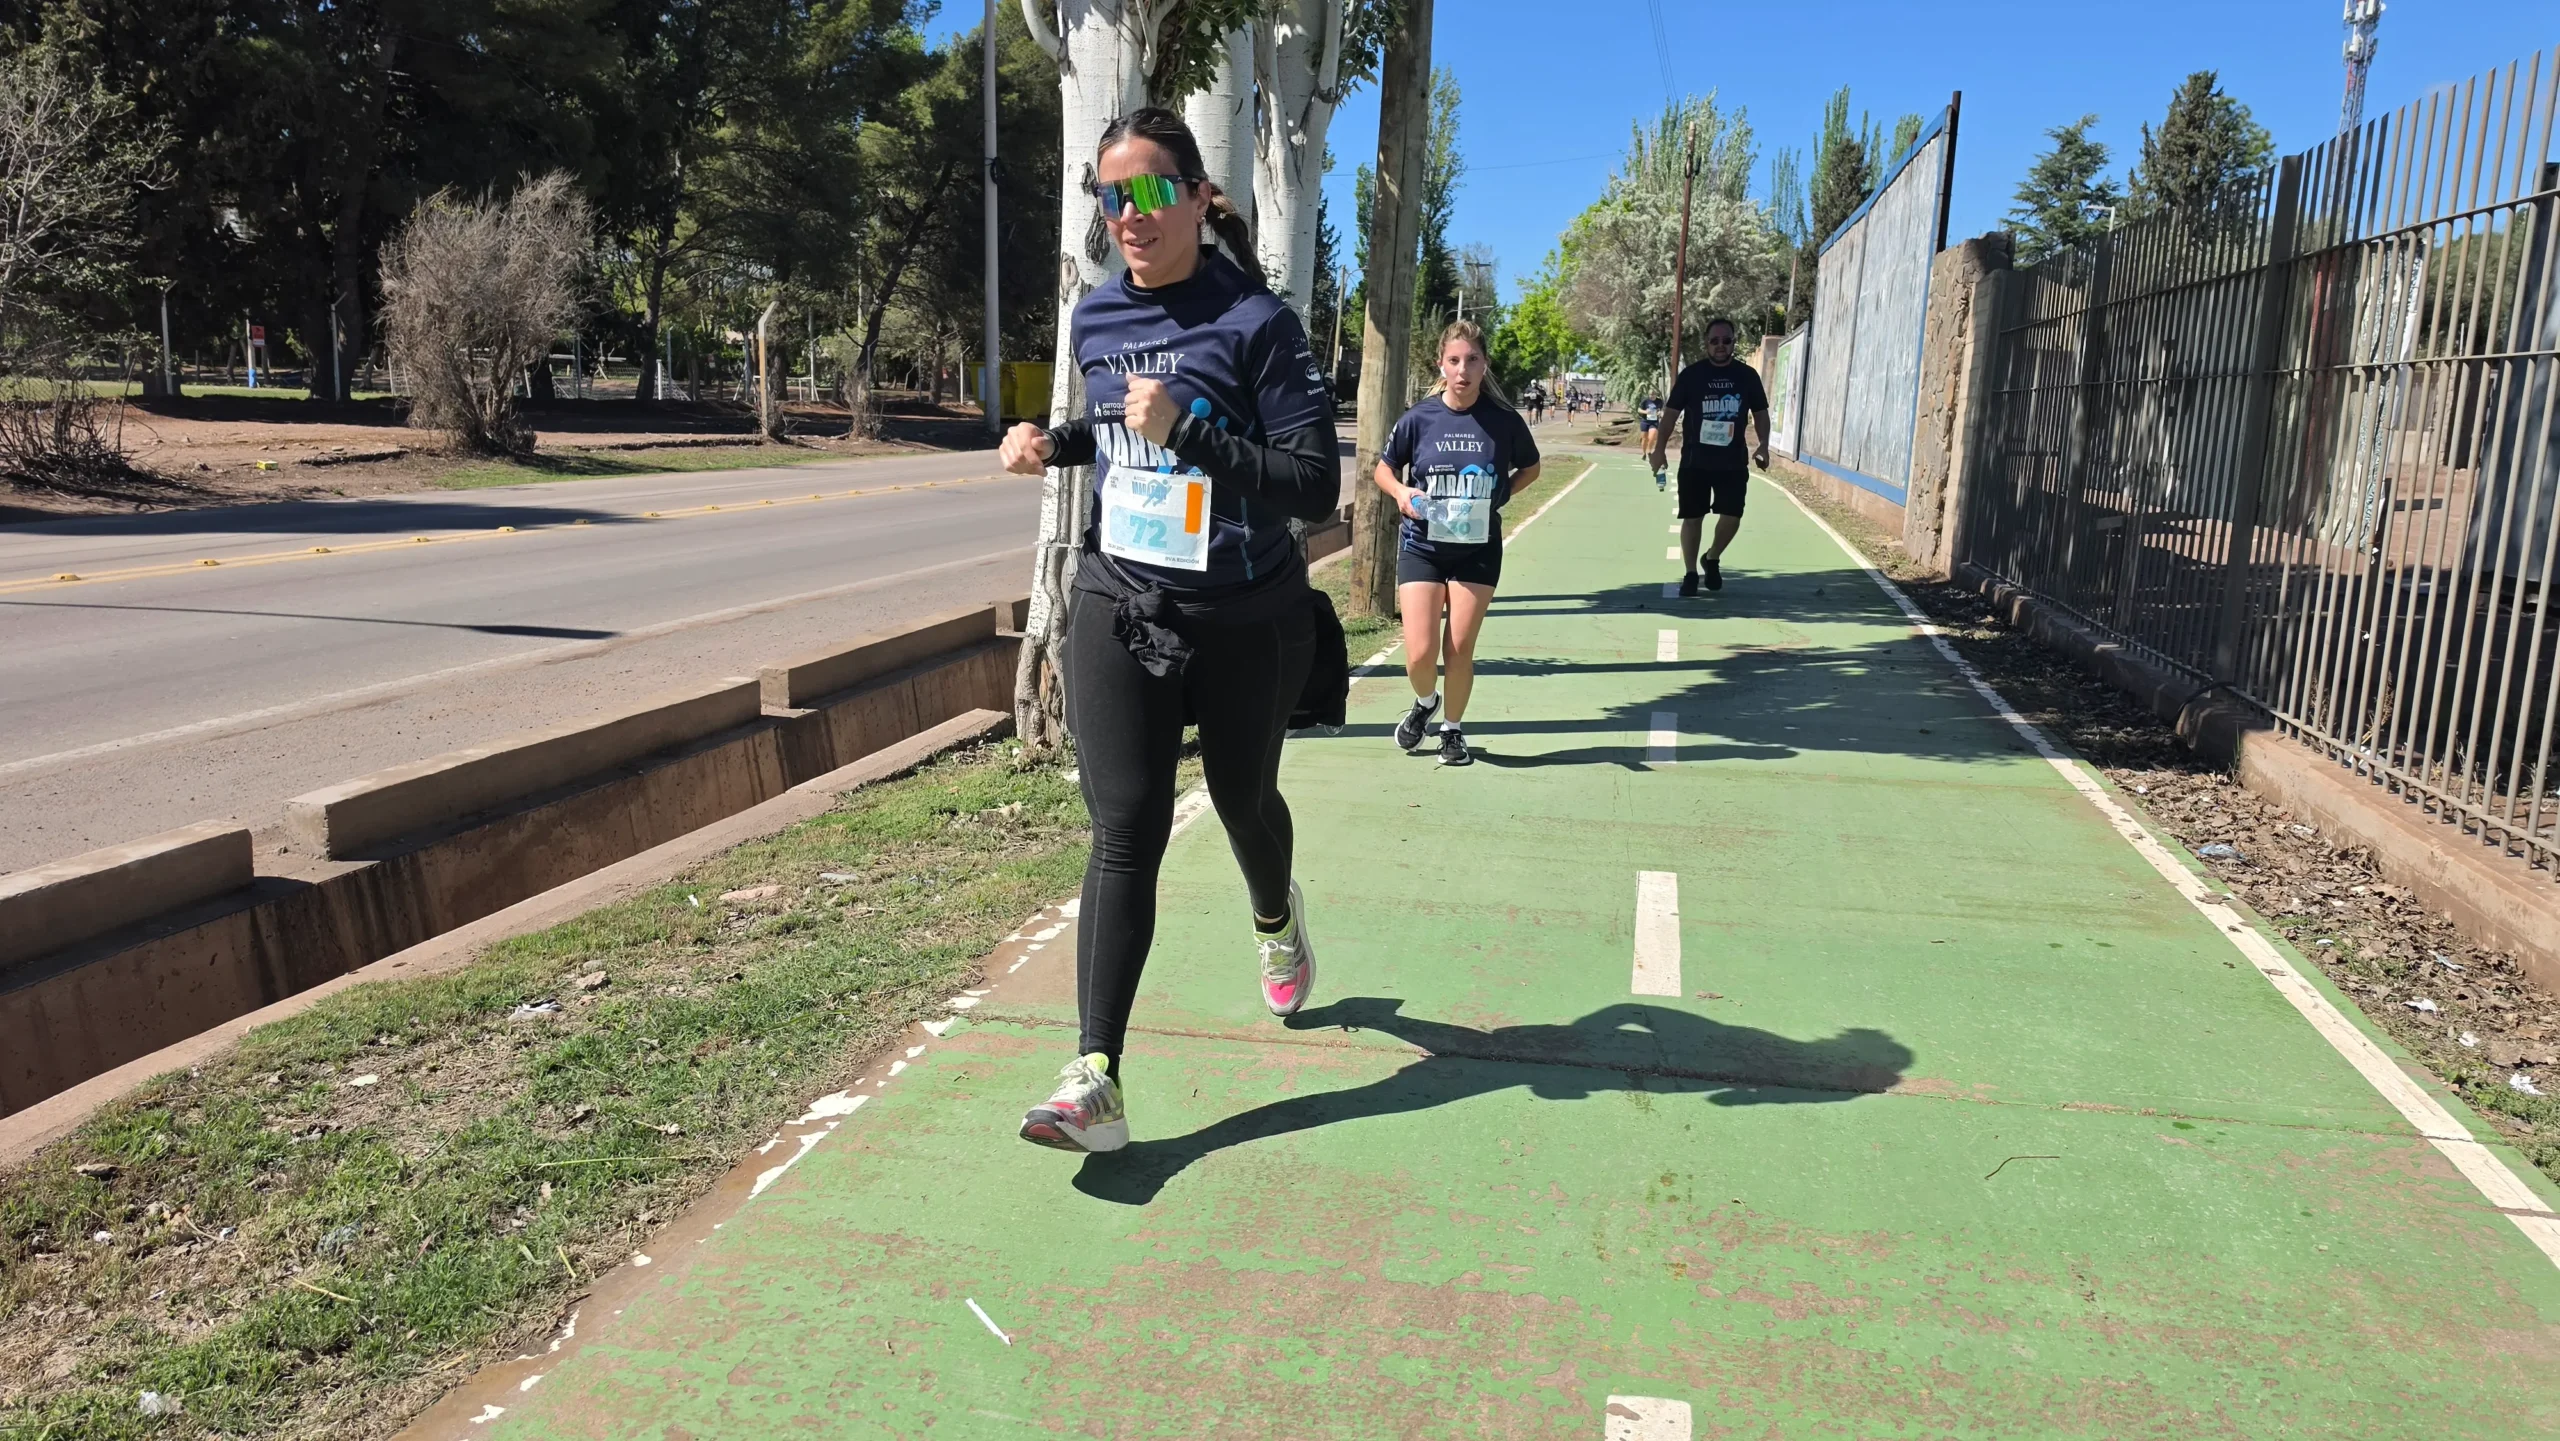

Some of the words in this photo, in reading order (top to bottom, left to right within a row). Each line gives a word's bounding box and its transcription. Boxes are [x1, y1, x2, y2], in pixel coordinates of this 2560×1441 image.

[1102, 352, 1185, 375] VALLEY
[1102, 402, 1127, 410] parroqui
[1435, 441, 1484, 452] VALLEY
[1129, 514, 1168, 549] 72
